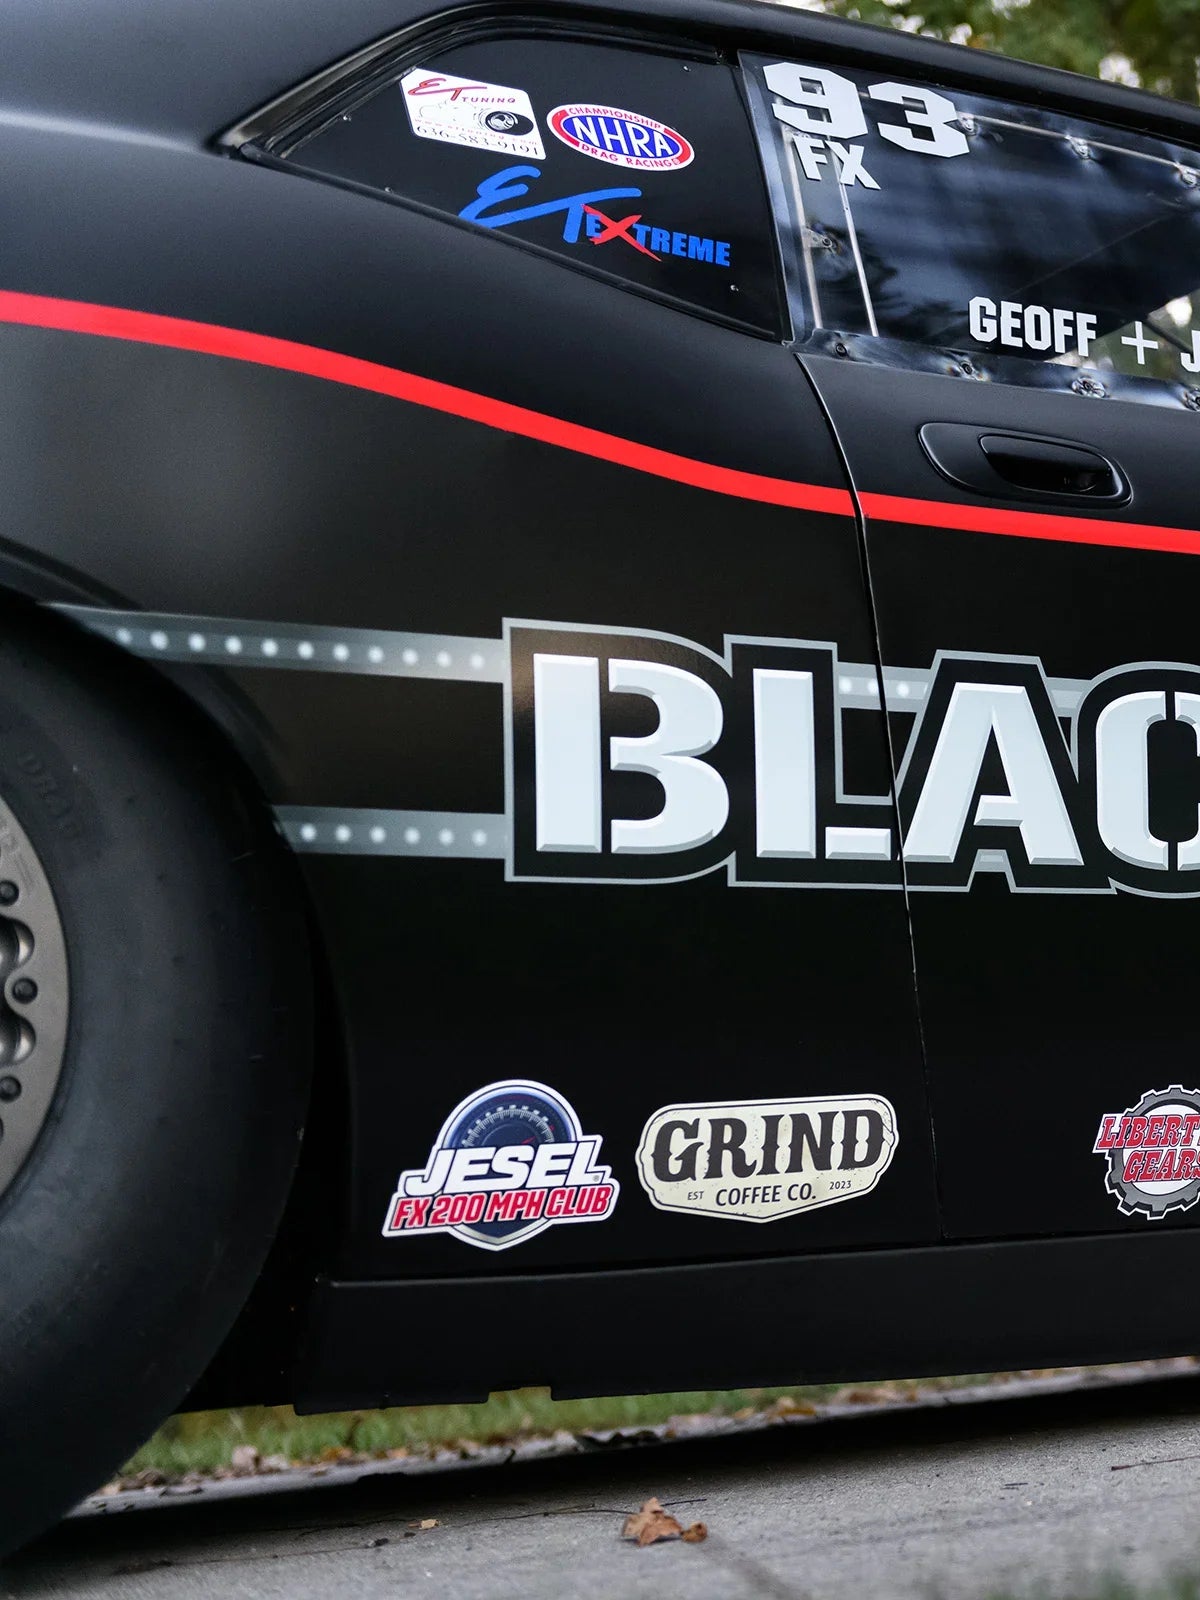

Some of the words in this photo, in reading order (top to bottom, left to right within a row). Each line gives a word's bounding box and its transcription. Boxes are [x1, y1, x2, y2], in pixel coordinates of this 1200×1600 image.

[568, 107, 661, 129] CHAMPIONSHIP
[763, 62, 970, 157] 93
[416, 126, 538, 156] 636-583-9191
[572, 116, 674, 158] NHRA
[581, 143, 618, 161] DRAG
[792, 137, 881, 190] FX
[969, 296, 1097, 357] GEOFF
[651, 1109, 888, 1184] GRIND
[404, 1141, 604, 1197] JESEL
[391, 1197, 430, 1229] FX
[429, 1194, 487, 1227] 200
[484, 1190, 547, 1223] MPH
[545, 1185, 613, 1218] CLUB
[687, 1191, 704, 1201] EST
[715, 1185, 781, 1207] COFFEE
[787, 1183, 817, 1202] CO.
[829, 1180, 852, 1191] 2023
